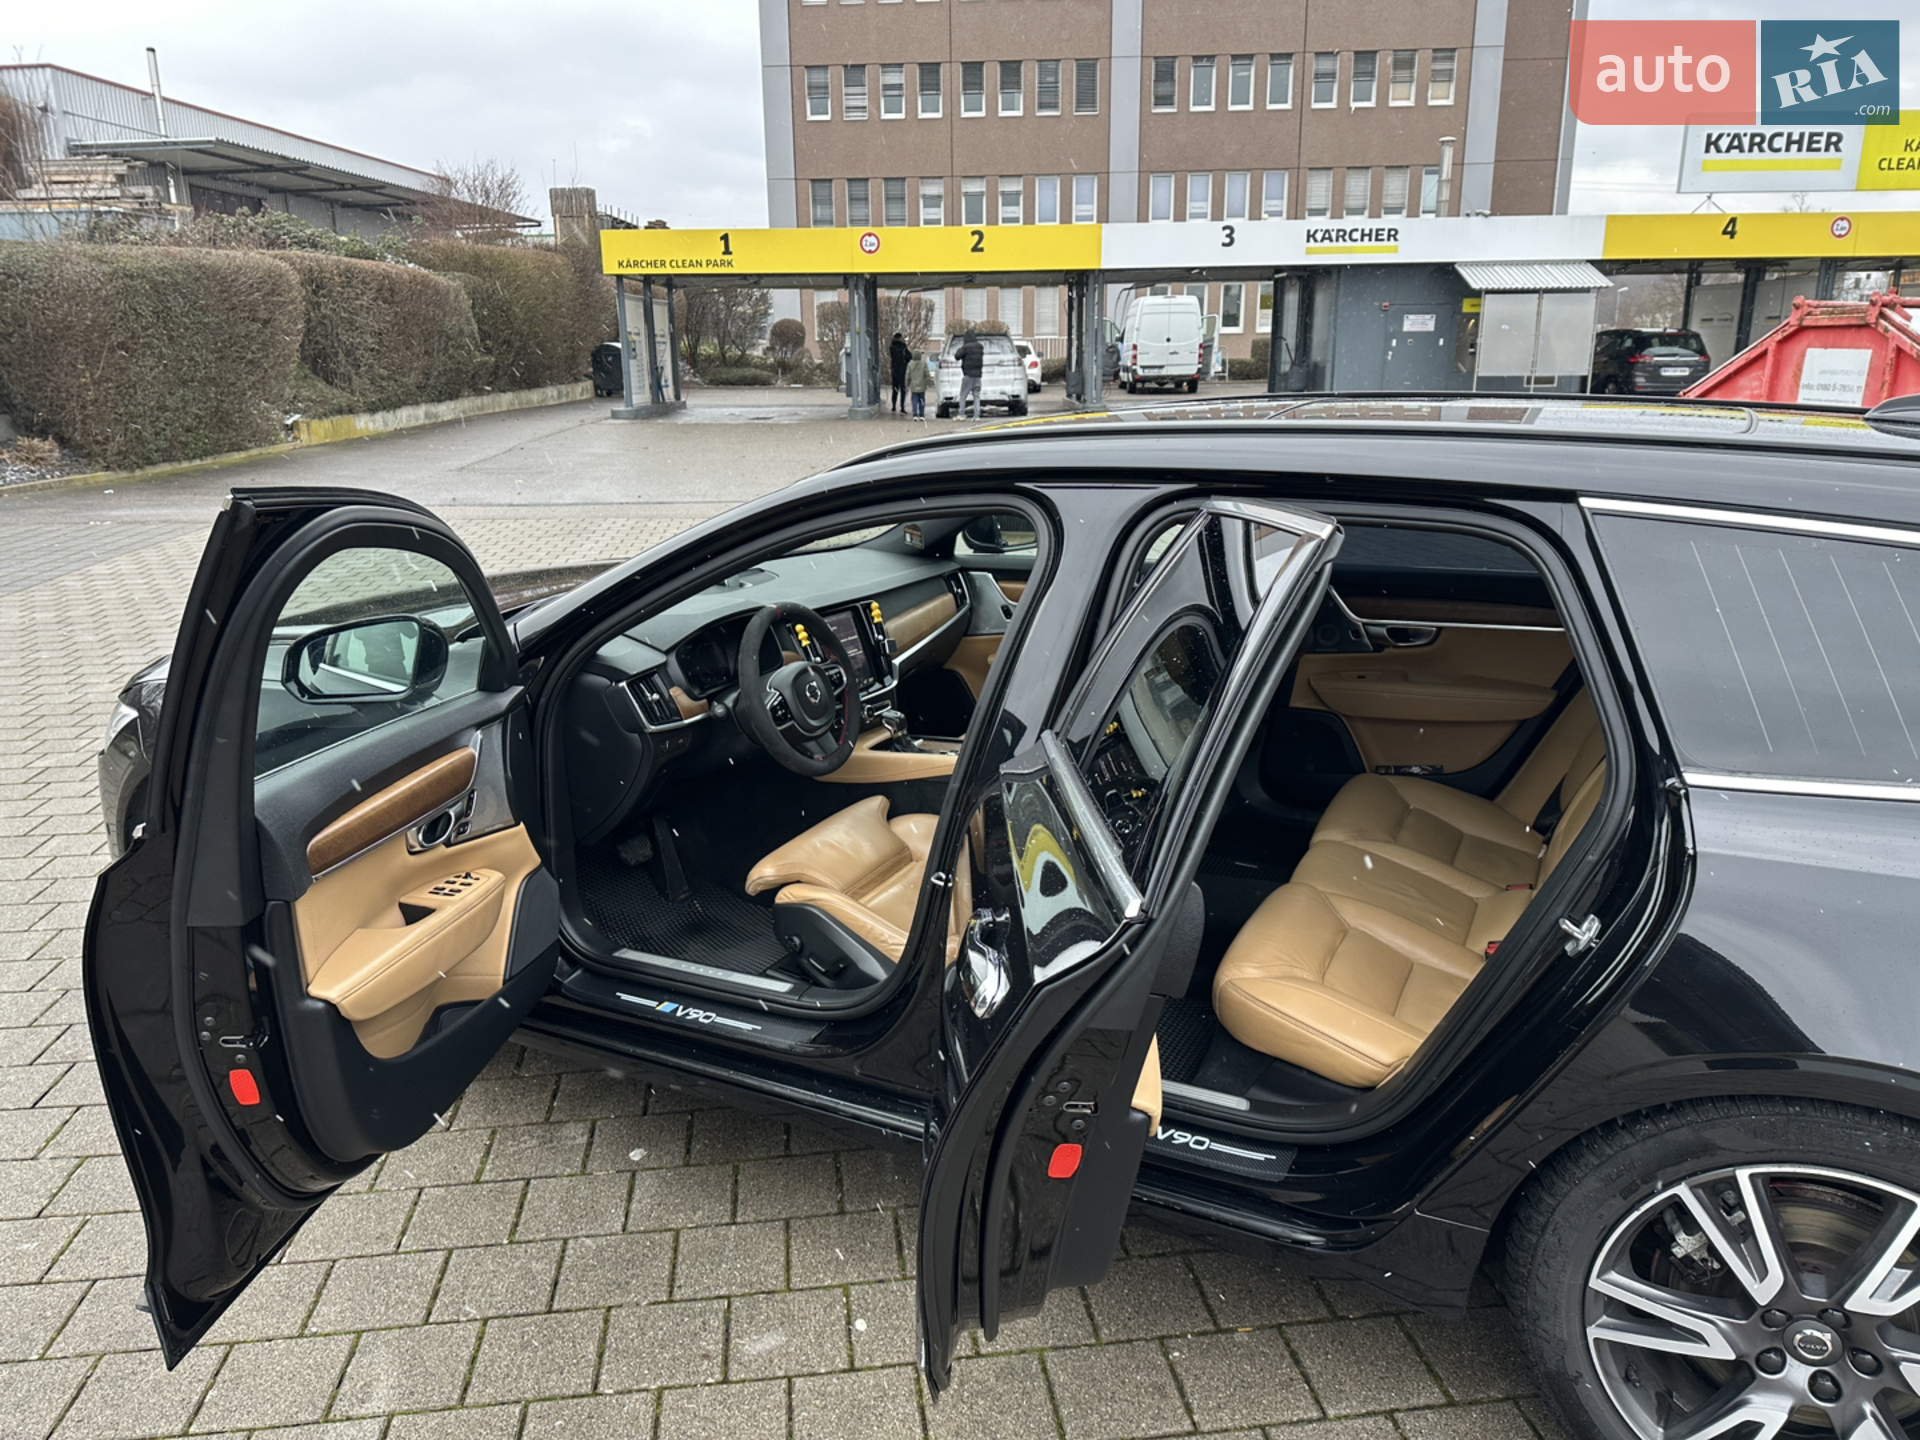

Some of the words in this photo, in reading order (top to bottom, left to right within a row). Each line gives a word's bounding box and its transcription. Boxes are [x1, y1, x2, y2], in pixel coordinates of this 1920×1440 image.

[1704, 131, 1844, 154] KÄRCHER
[1221, 225, 1235, 247] 3
[1306, 227, 1399, 243] KÄRCHER
[1721, 216, 1738, 239] 4
[719, 232, 733, 255] 1
[970, 229, 985, 253] 2
[617, 258, 667, 269] KÄRCHER
[669, 259, 703, 269] CLEAN
[706, 258, 734, 268] PARK
[675, 1005, 716, 1024] V90
[1156, 1125, 1211, 1150] V90
